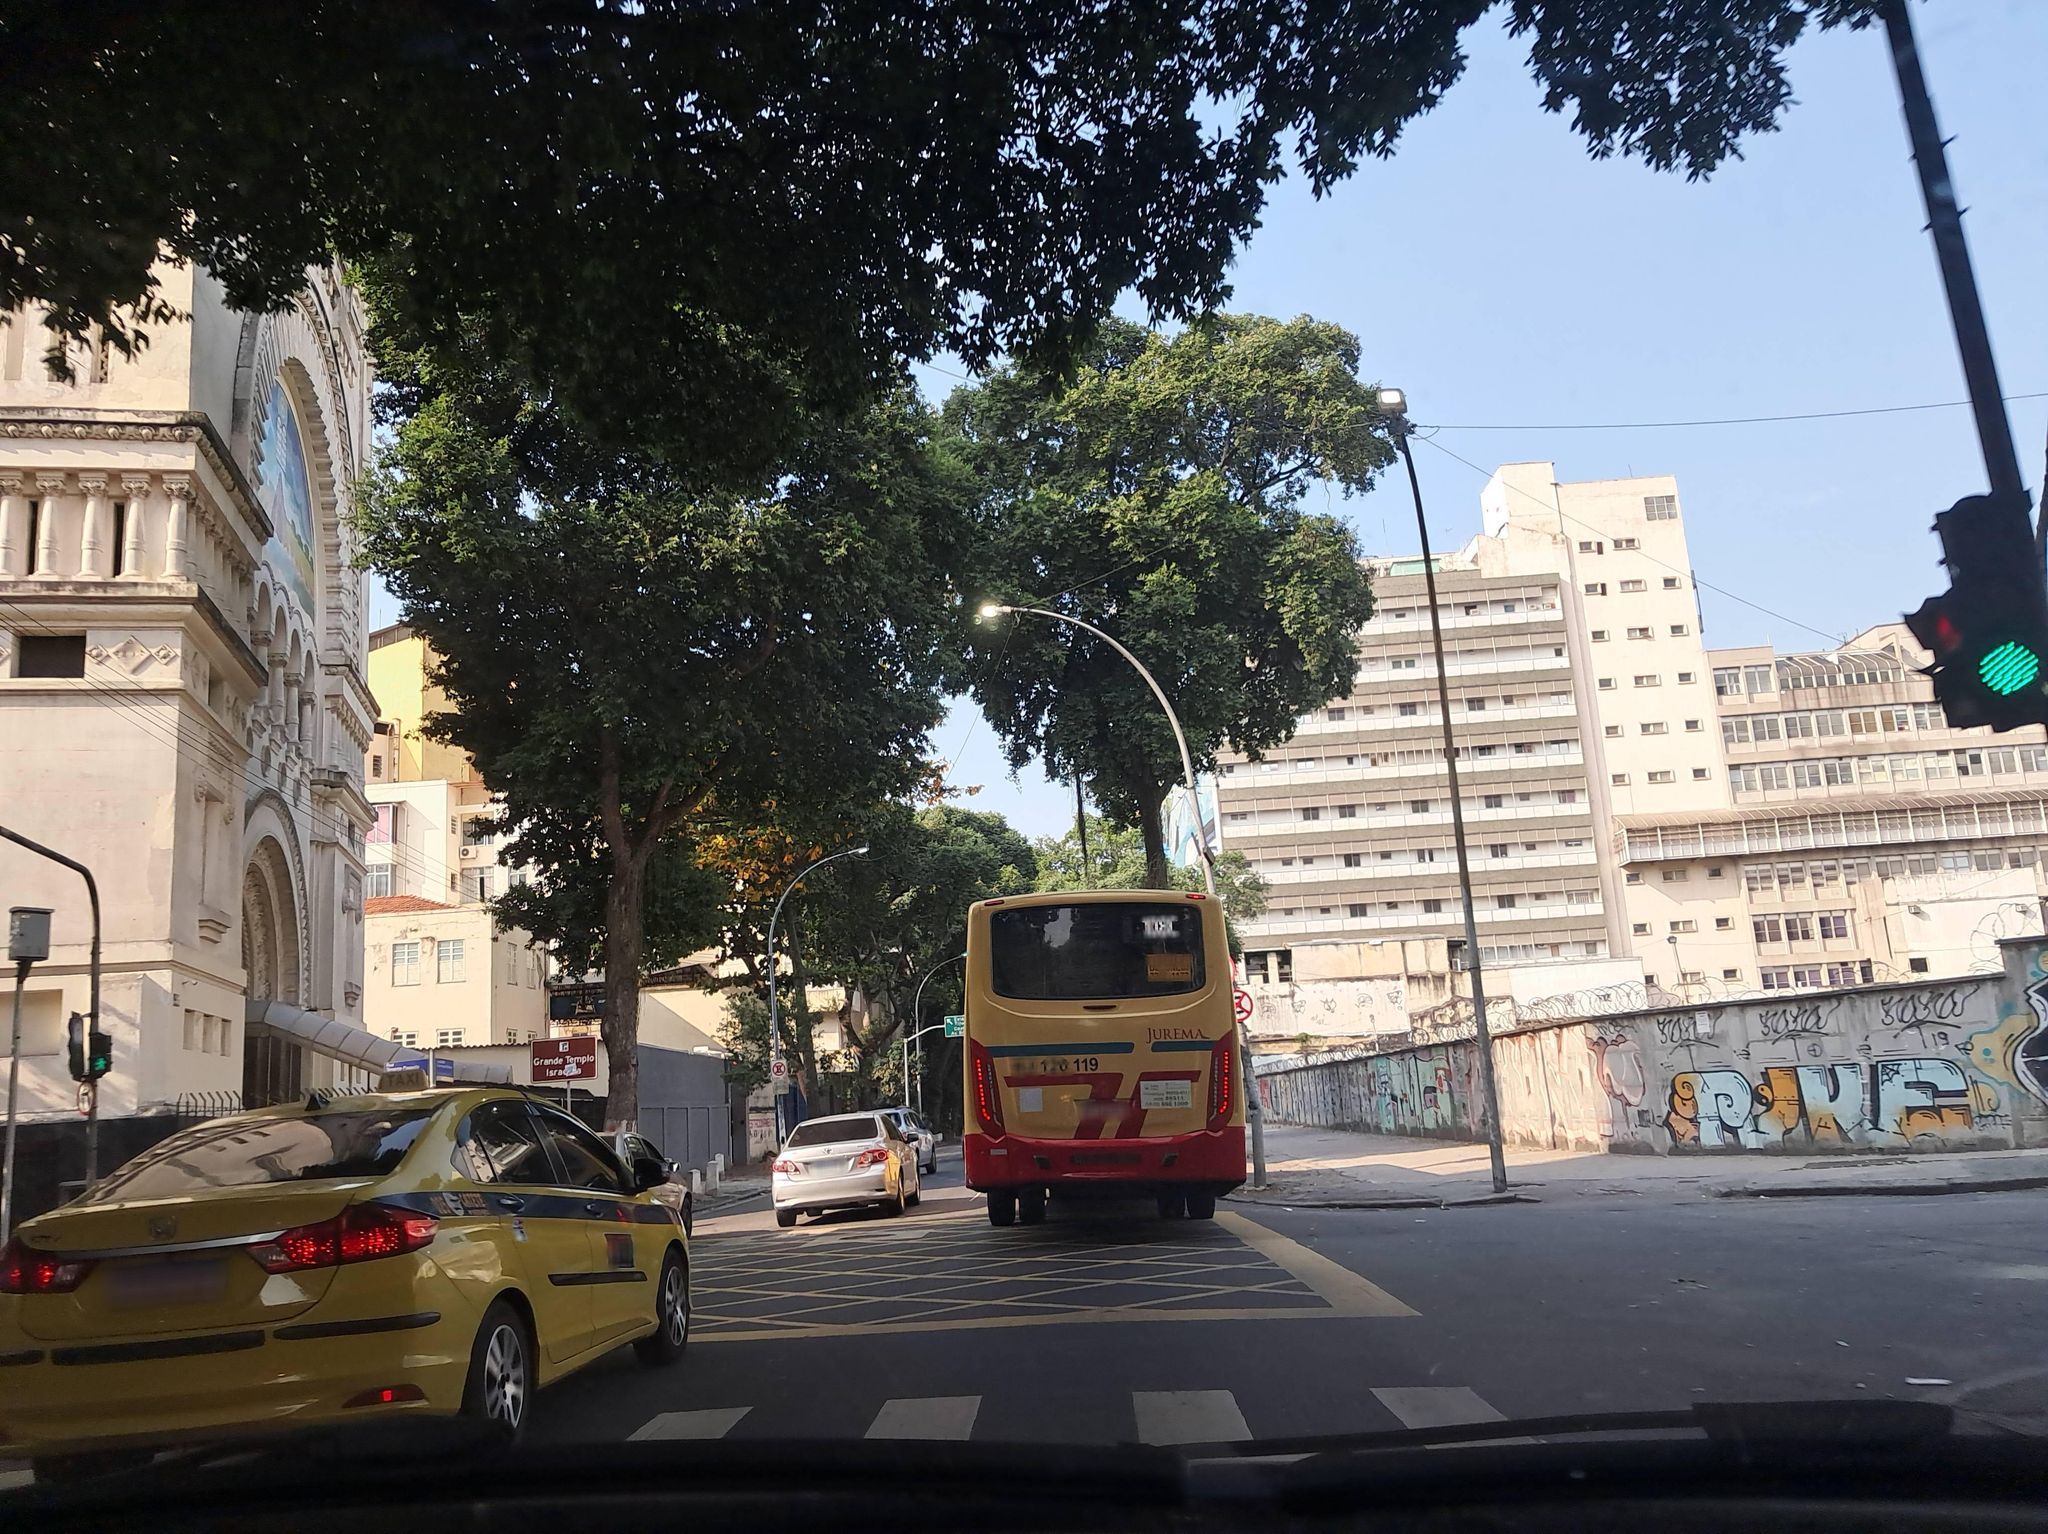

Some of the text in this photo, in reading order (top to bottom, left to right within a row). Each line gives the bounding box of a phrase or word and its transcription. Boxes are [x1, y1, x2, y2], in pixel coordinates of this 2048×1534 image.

[1146, 1027, 1211, 1044] JUREMA
[533, 1054, 595, 1066] Grande Templo
[1073, 1056, 1099, 1072] 119
[388, 1072, 419, 1086] TAXI
